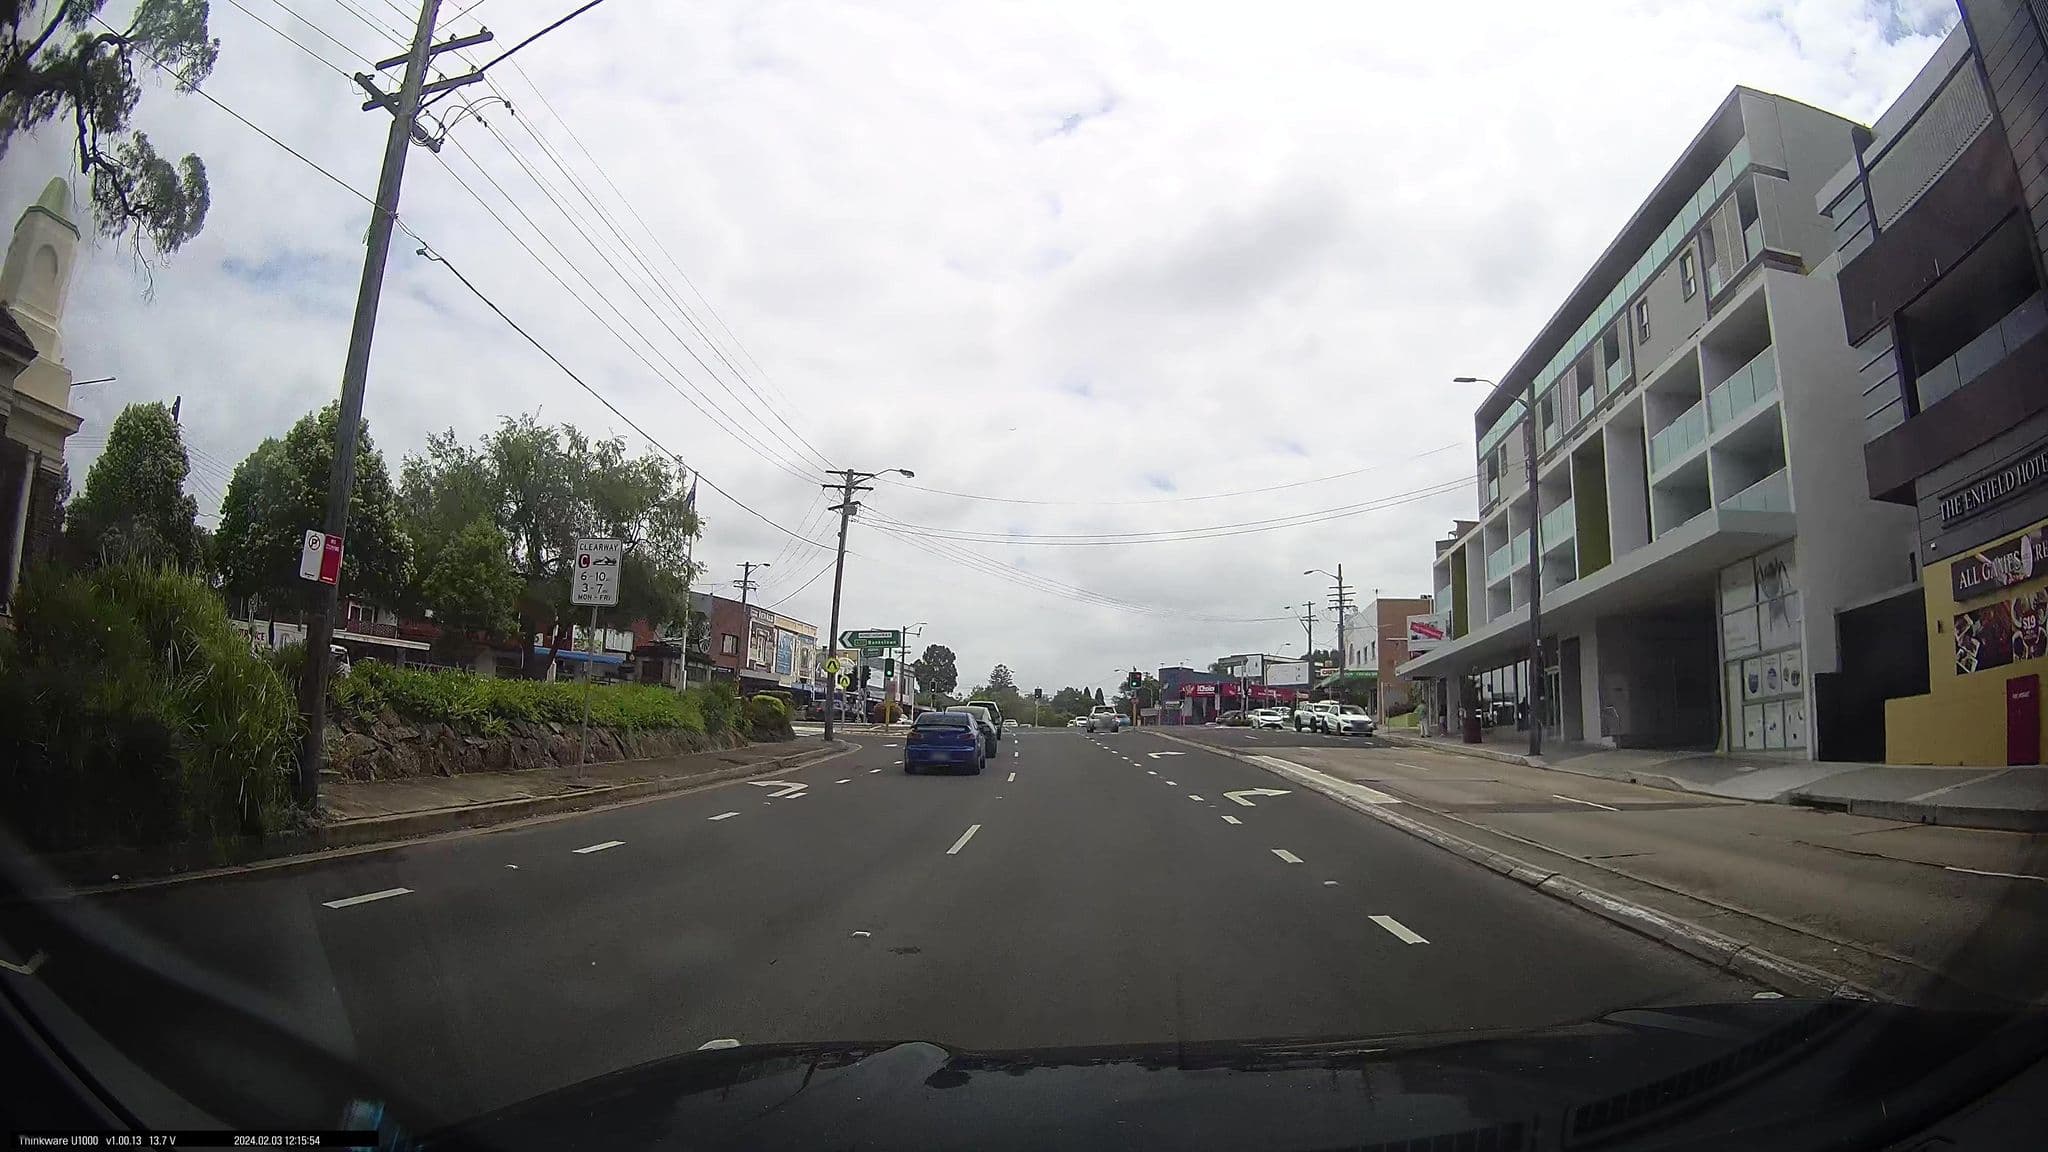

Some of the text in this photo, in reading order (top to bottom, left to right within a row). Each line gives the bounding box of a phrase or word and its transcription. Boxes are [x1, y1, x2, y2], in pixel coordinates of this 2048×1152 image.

[1940, 497, 1963, 520] THE
[1964, 470, 2015, 510] ENFIELD
[579, 543, 619, 551] CLEARWAY
[1960, 566, 1981, 590] ALL
